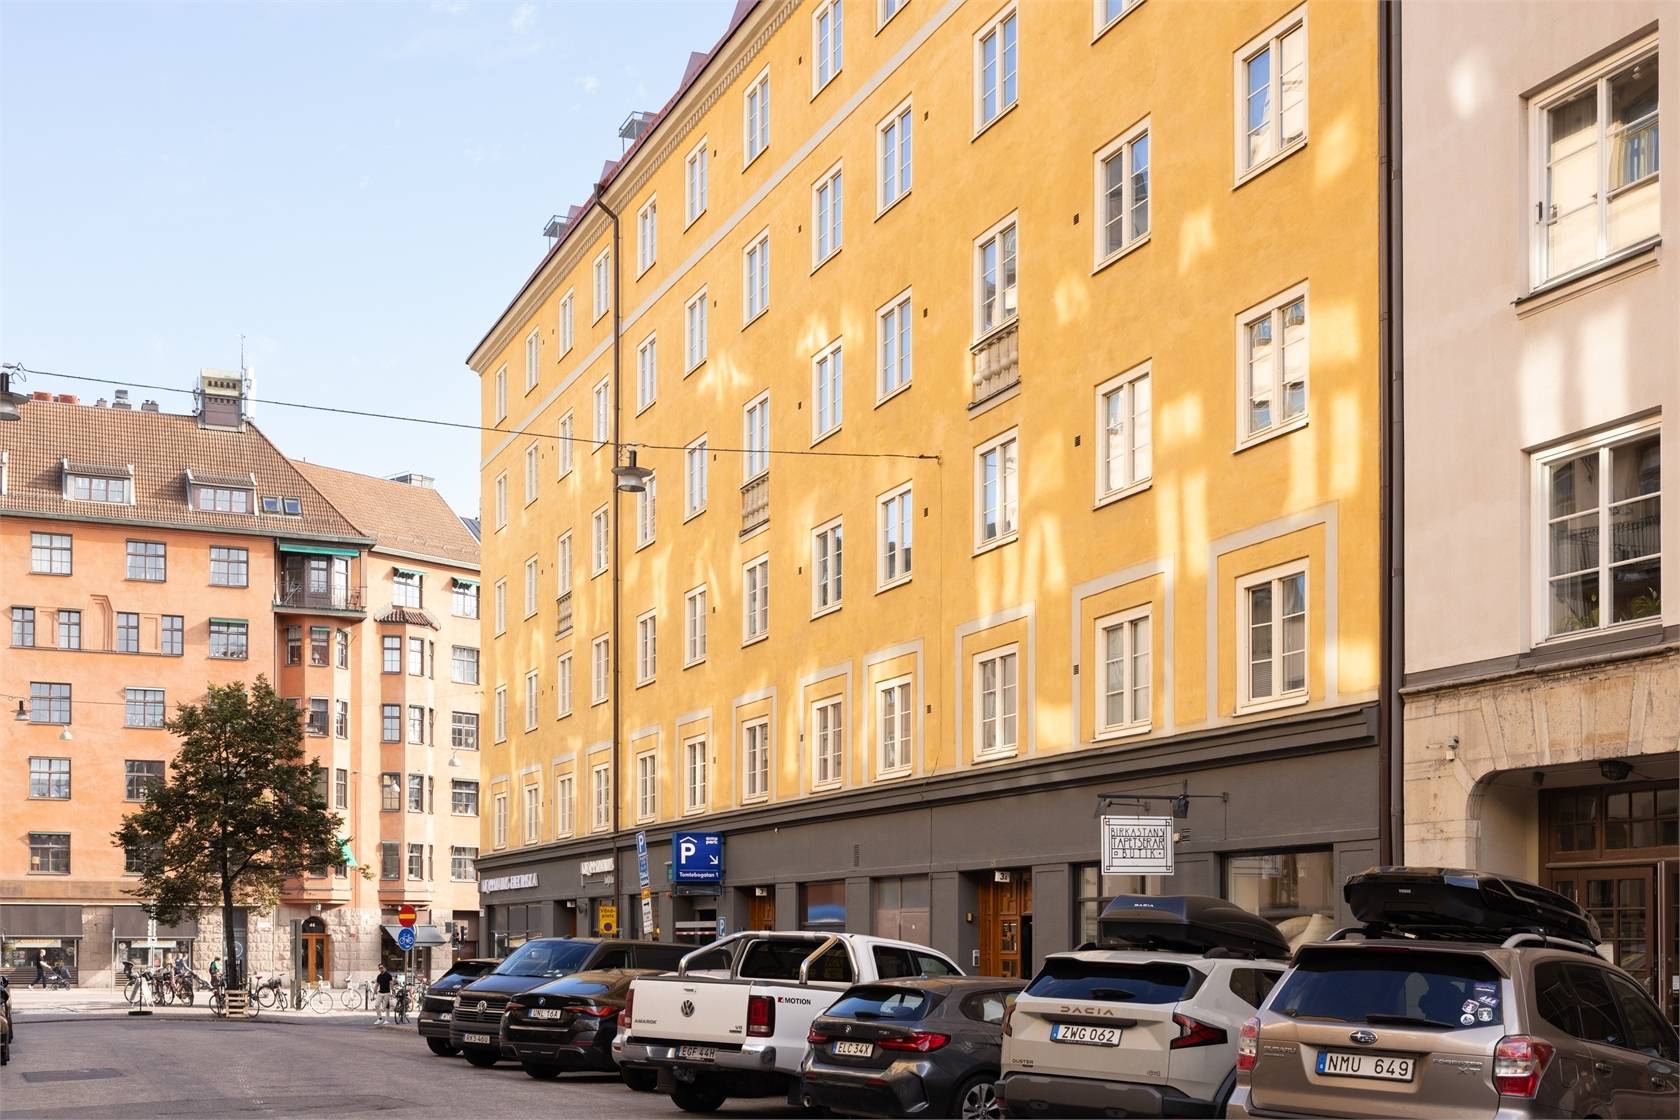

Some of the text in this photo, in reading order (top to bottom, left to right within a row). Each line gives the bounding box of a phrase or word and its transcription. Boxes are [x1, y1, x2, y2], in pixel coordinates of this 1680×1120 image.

[1111, 827, 1165, 837] BIRKASTANS
[638, 835, 644, 852] P
[1111, 837, 1165, 849] TAPETSERAR
[680, 842, 696, 864] P
[1122, 849, 1156, 858] BUTIK
[679, 871, 715, 879] Tomtebogatan
[1060, 1006, 1114, 1016] DACIA
[1062, 1026, 1086, 1040] ZWG
[1089, 1028, 1114, 1043] 062
[682, 1046, 699, 1057] EGF
[1327, 1055, 1409, 1077] NMU 649
